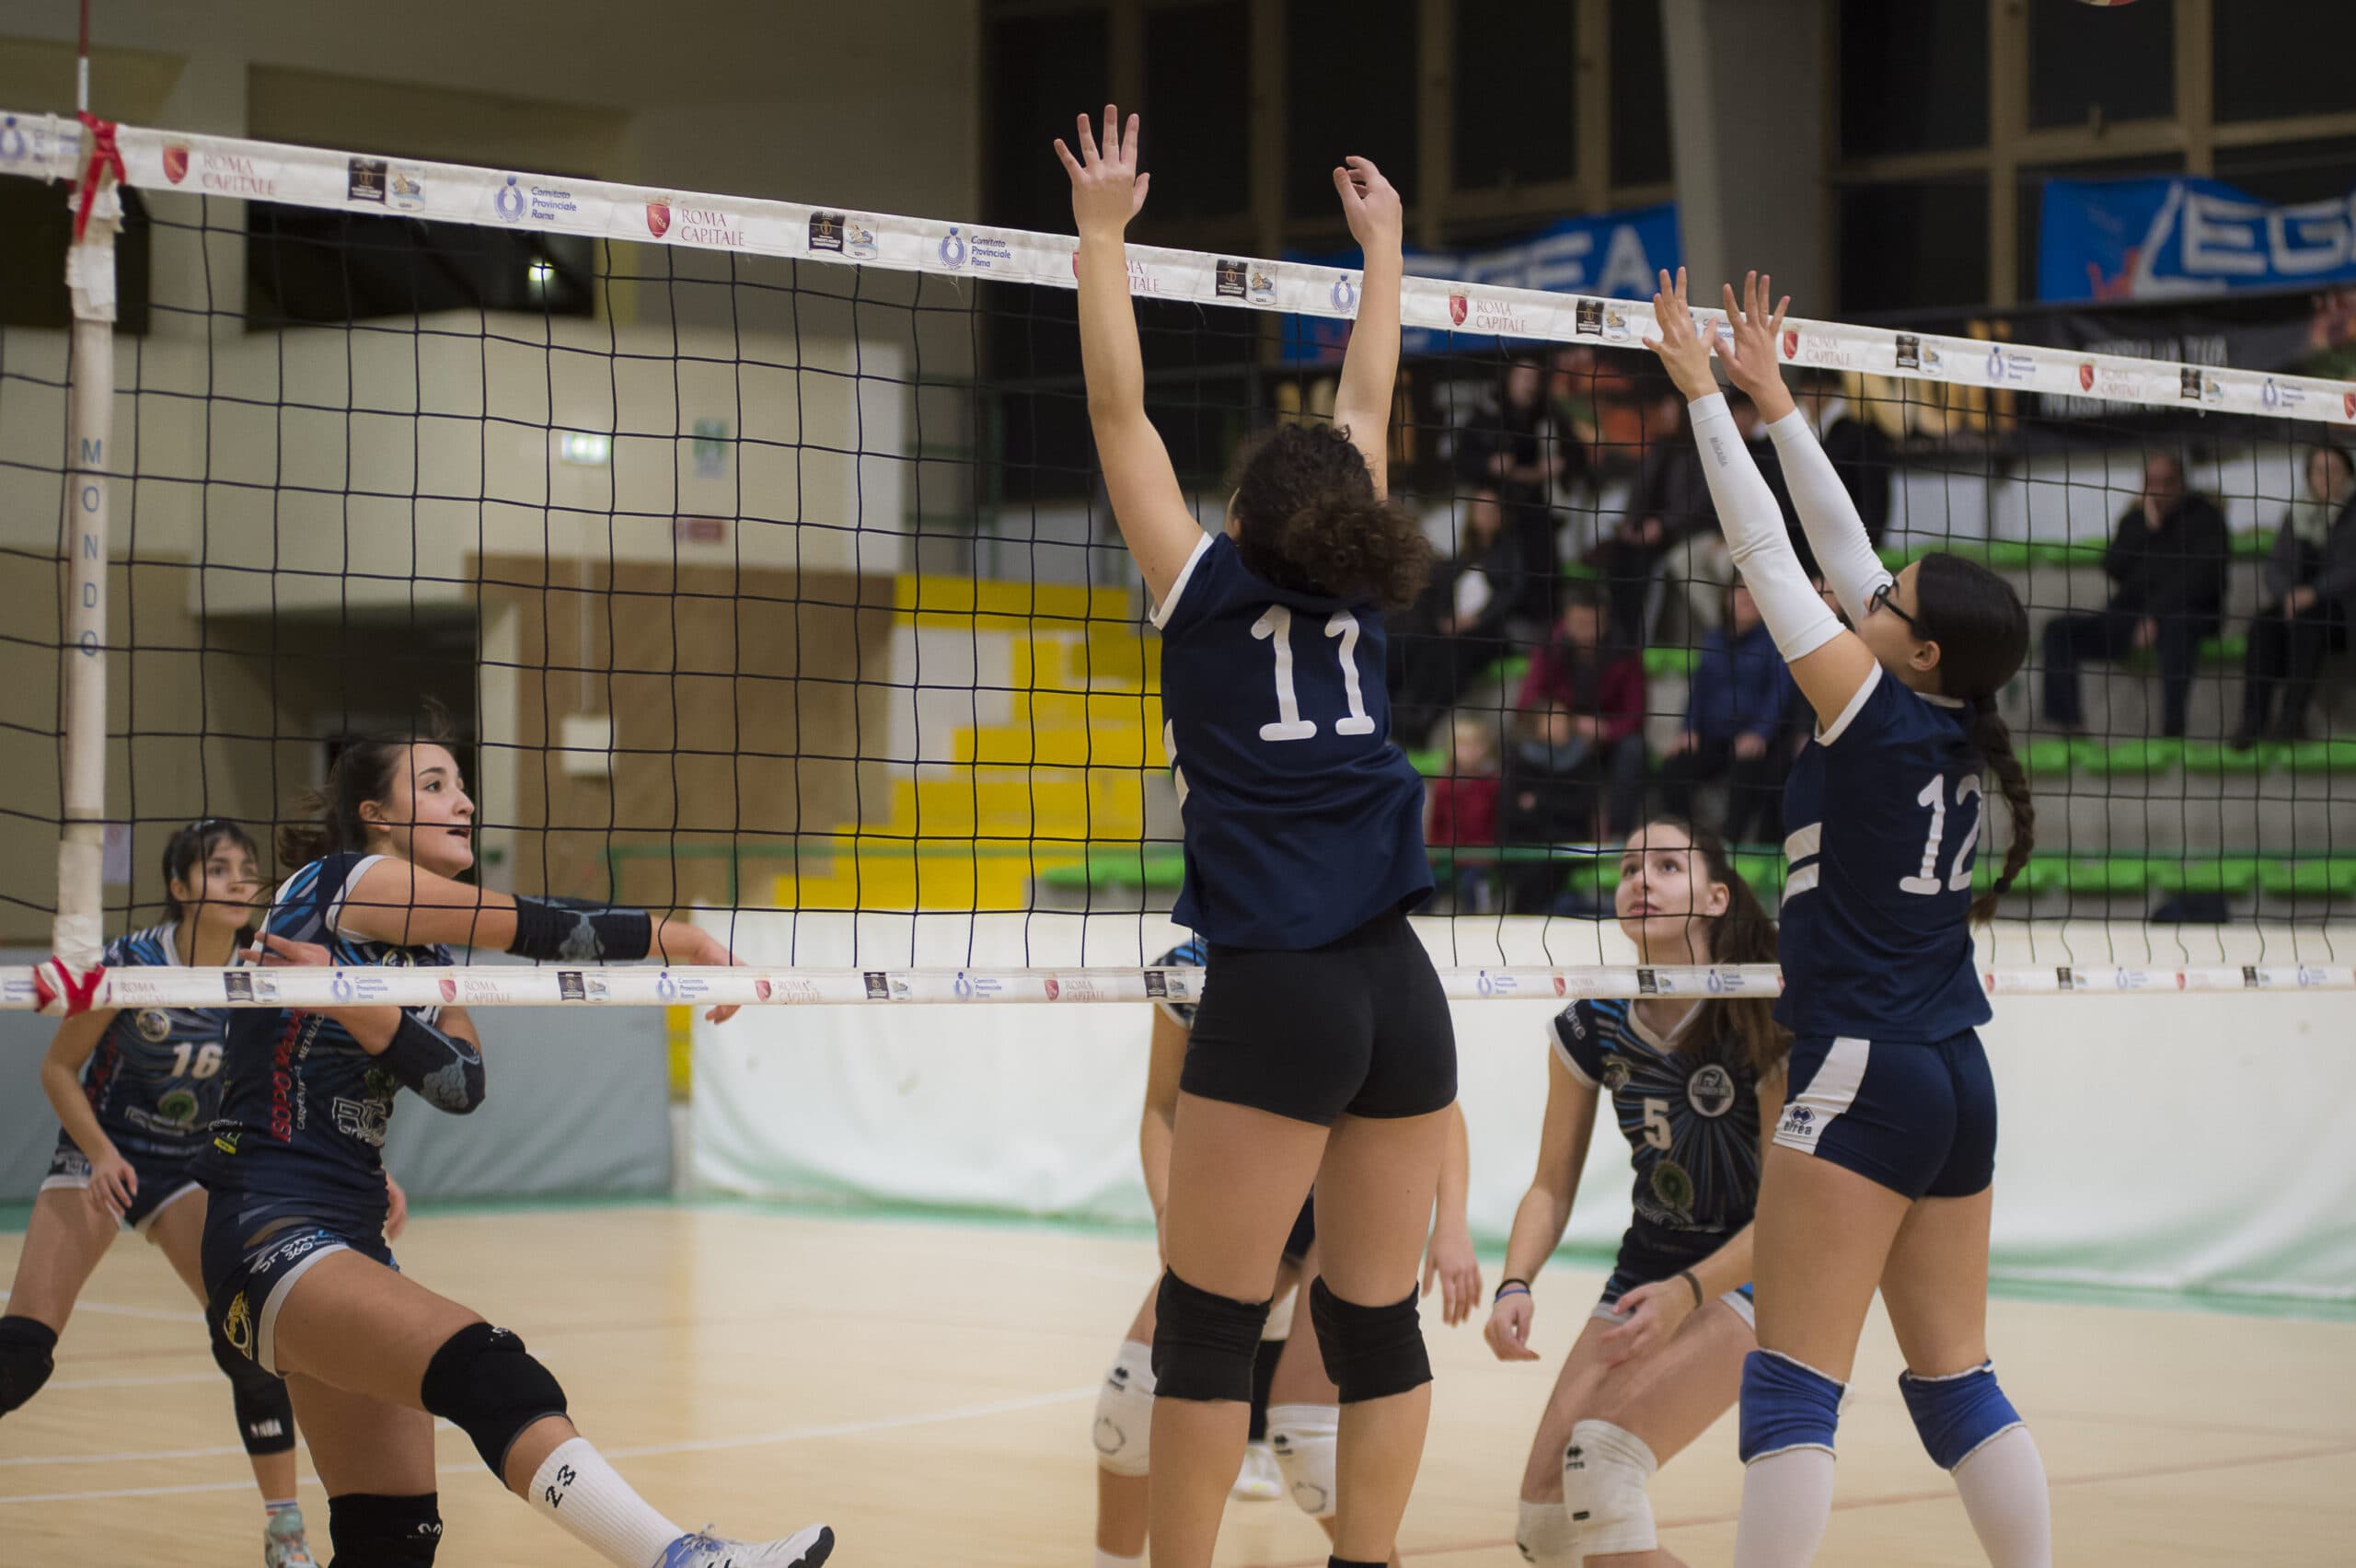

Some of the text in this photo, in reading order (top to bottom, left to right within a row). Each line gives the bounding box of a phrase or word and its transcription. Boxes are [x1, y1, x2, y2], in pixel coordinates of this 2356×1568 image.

[203, 155, 253, 175] ROMA
[202, 174, 275, 195] CAPITALE
[531, 186, 571, 199] Comitato
[532, 197, 577, 212] Provinciale
[531, 209, 554, 221] Roma
[682, 208, 727, 227] ROMA
[681, 225, 744, 247] CAPITALE
[971, 235, 1006, 248] Comitato
[2133, 180, 2356, 299] LEG
[972, 245, 1011, 259] Provinciale
[971, 257, 991, 268] Roma
[1476, 301, 1512, 316] ROMA
[1476, 315, 1525, 332] CAPITALE
[80, 437, 102, 658] MONDO
[1251, 605, 1375, 742] 11
[1899, 773, 1981, 895] 12
[171, 1043, 224, 1079] 16
[1644, 1098, 1672, 1150] 5
[545, 1464, 576, 1508] 23
